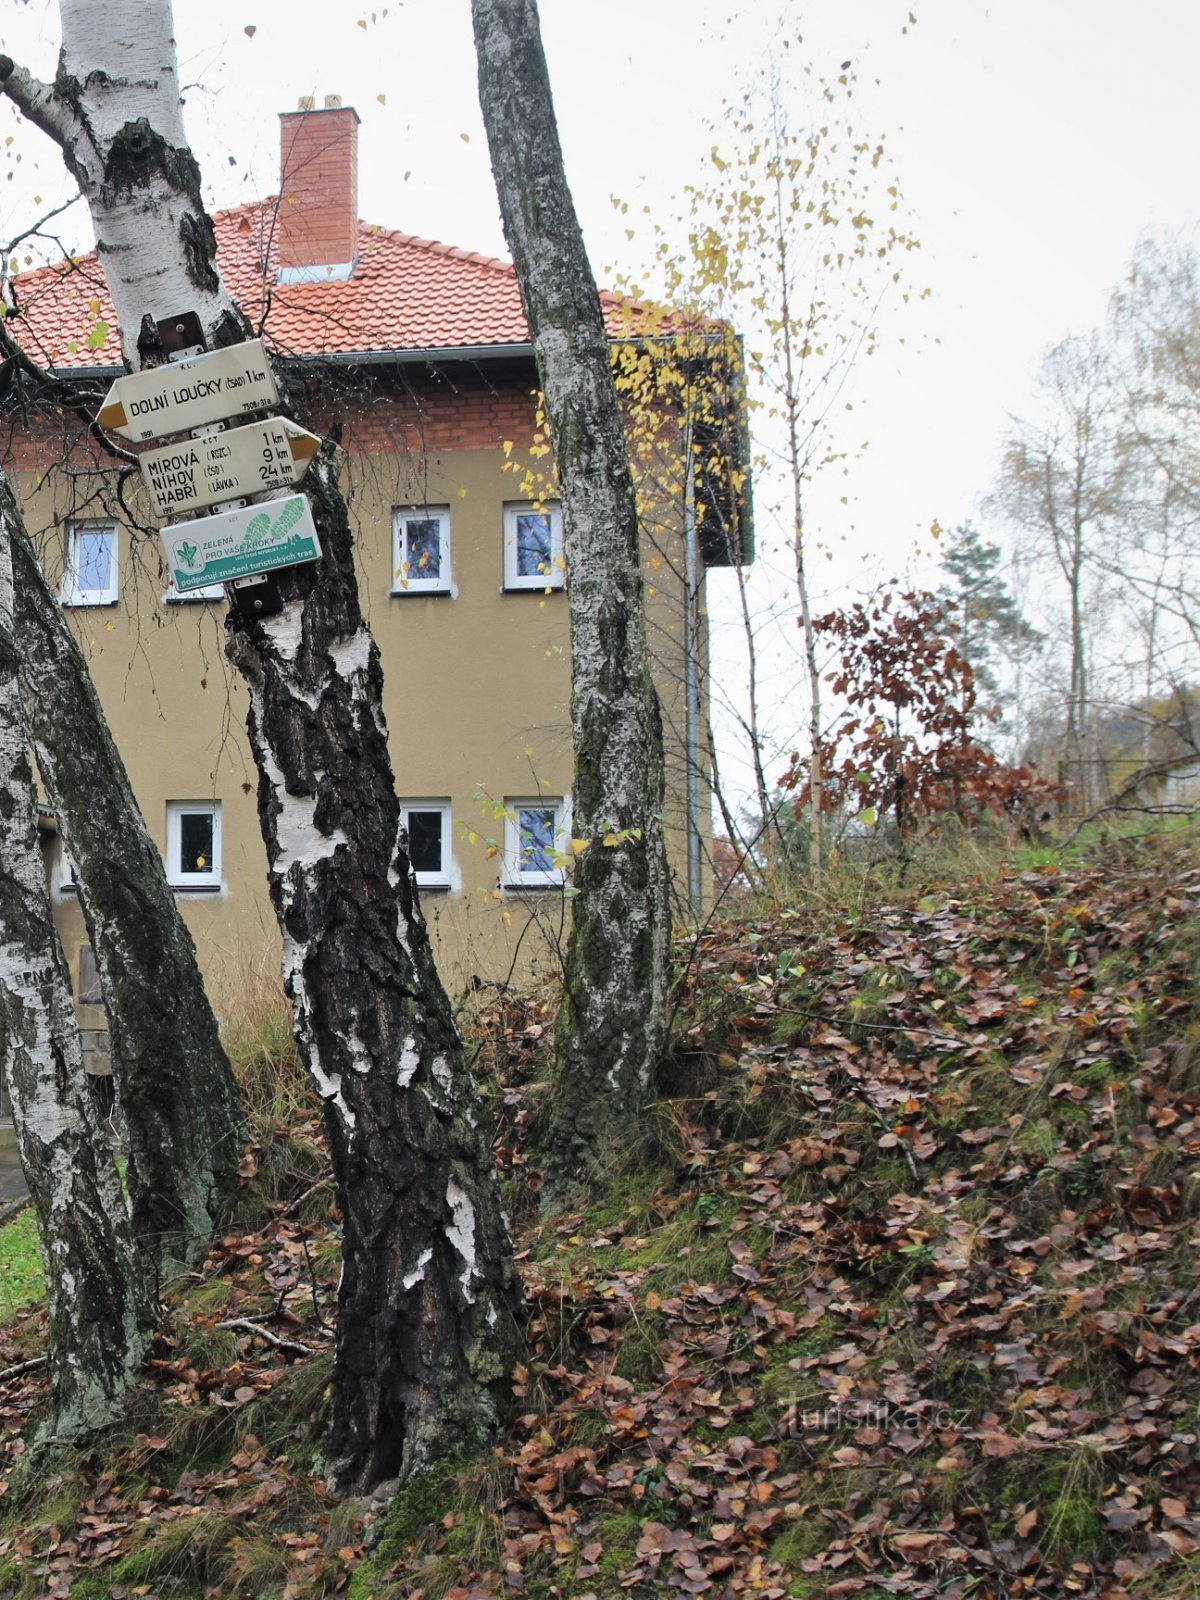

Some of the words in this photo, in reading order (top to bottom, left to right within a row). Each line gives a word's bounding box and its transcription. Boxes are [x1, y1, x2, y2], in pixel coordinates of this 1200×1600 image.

[130, 390, 170, 417] DOLNÍ
[173, 379, 222, 404] LOUČKY
[246, 370, 252, 383] 1
[252, 370, 266, 382] km
[140, 430, 153, 439] 1991
[148, 452, 200, 476] MÍROVÁ
[263, 432, 270, 446] 1
[272, 432, 284, 444] km
[152, 469, 194, 491] NÍHOV
[203, 464, 225, 478] (ČSD)
[262, 449, 273, 463] 9
[275, 448, 289, 460] km
[156, 482, 198, 506] HABŘÍ
[258, 464, 278, 480] 24
[280, 463, 293, 474] km
[162, 506, 175, 515] 1991
[202, 536, 234, 550] ZELENÁ
[205, 549, 223, 560] PRO
[224, 544, 246, 555] VAŠE
[246, 538, 275, 550] KROKY
[181, 570, 218, 587] podporují
[219, 564, 249, 577] značení
[250, 553, 296, 569] turistických
[297, 549, 314, 559] tras
